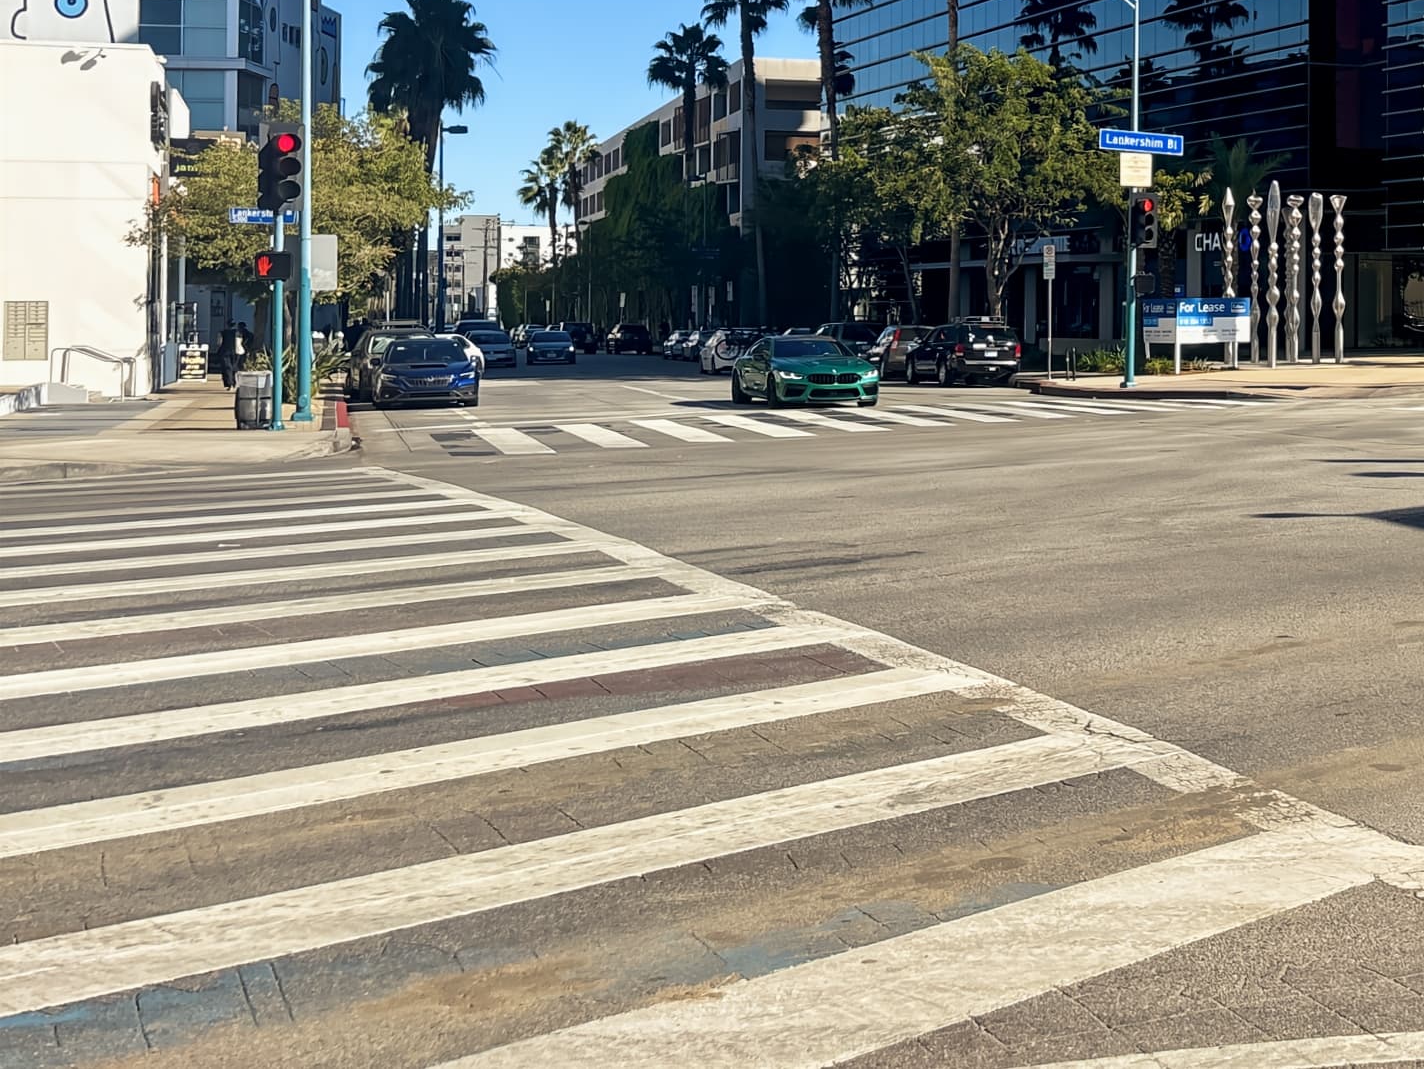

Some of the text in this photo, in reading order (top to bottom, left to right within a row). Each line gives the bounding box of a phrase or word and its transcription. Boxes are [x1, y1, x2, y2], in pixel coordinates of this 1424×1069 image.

[1105, 133, 1178, 151] Lankershim Bl
[1180, 302, 1195, 313] For
[1198, 302, 1225, 313] Lease
